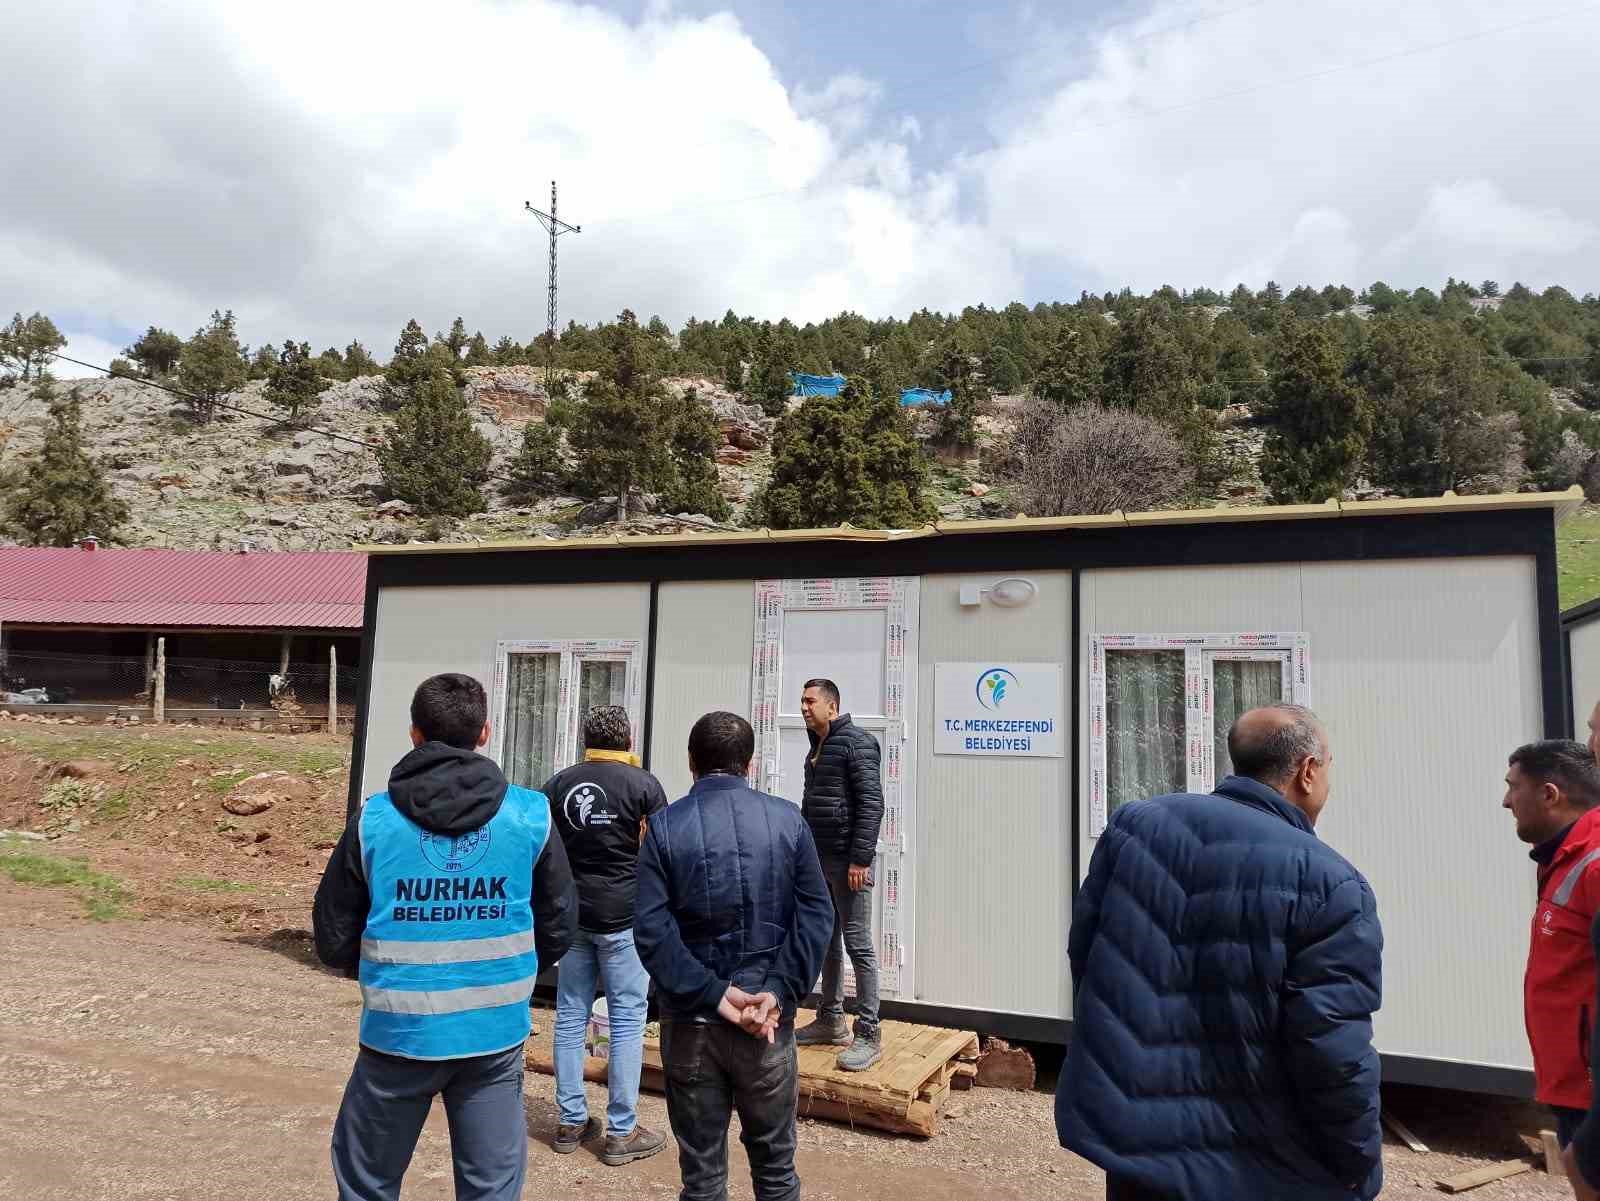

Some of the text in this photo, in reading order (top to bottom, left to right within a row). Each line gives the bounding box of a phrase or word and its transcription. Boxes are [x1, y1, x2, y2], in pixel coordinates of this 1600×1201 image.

[965, 718, 1053, 733] MERKEZEFENDİ
[966, 736, 1031, 751] BELEDİYESİ
[396, 877, 508, 901] NURHAK
[393, 903, 506, 922] BELEDİYESİ
